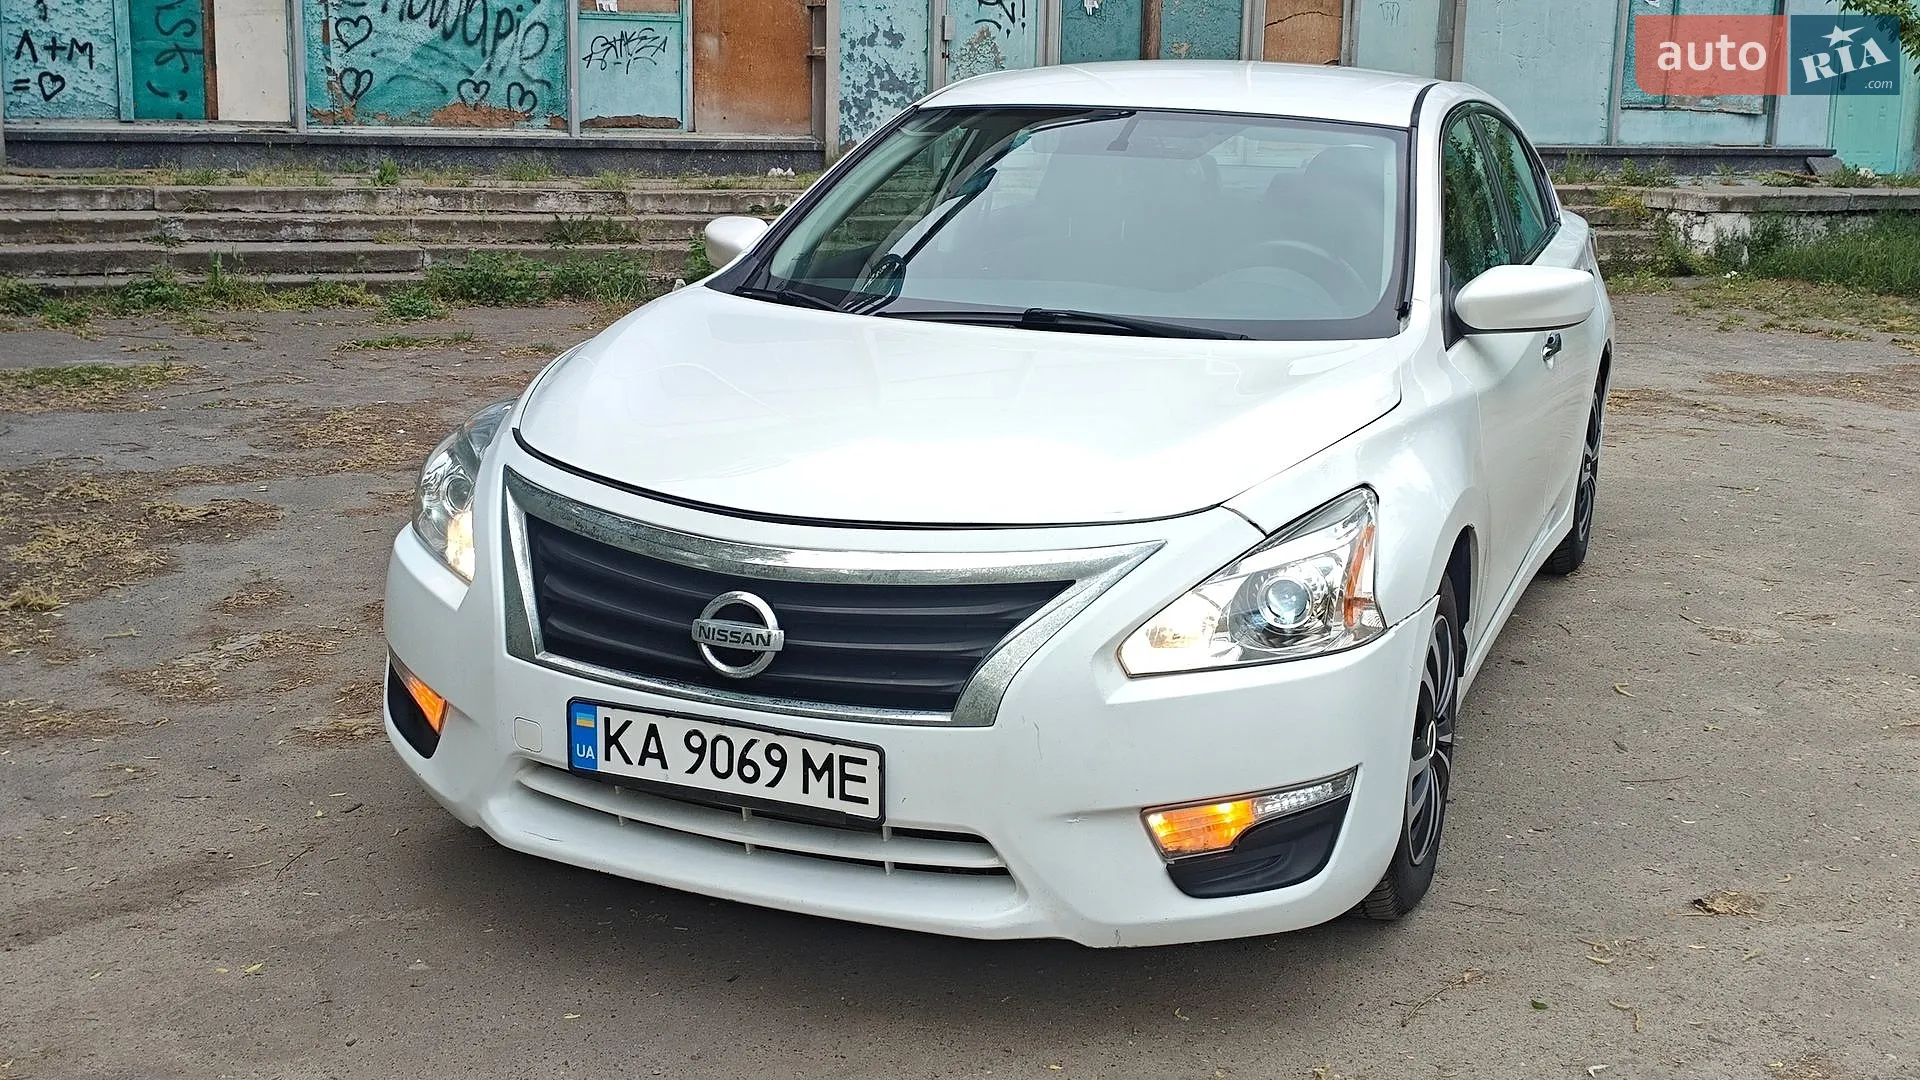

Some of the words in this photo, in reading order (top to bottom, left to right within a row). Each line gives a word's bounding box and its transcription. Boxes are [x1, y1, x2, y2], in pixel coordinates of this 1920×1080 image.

[698, 625, 772, 647] NISSAN
[576, 744, 595, 760] UA
[603, 716, 669, 770] KA
[683, 728, 788, 788] 9069
[801, 748, 870, 805] ME
